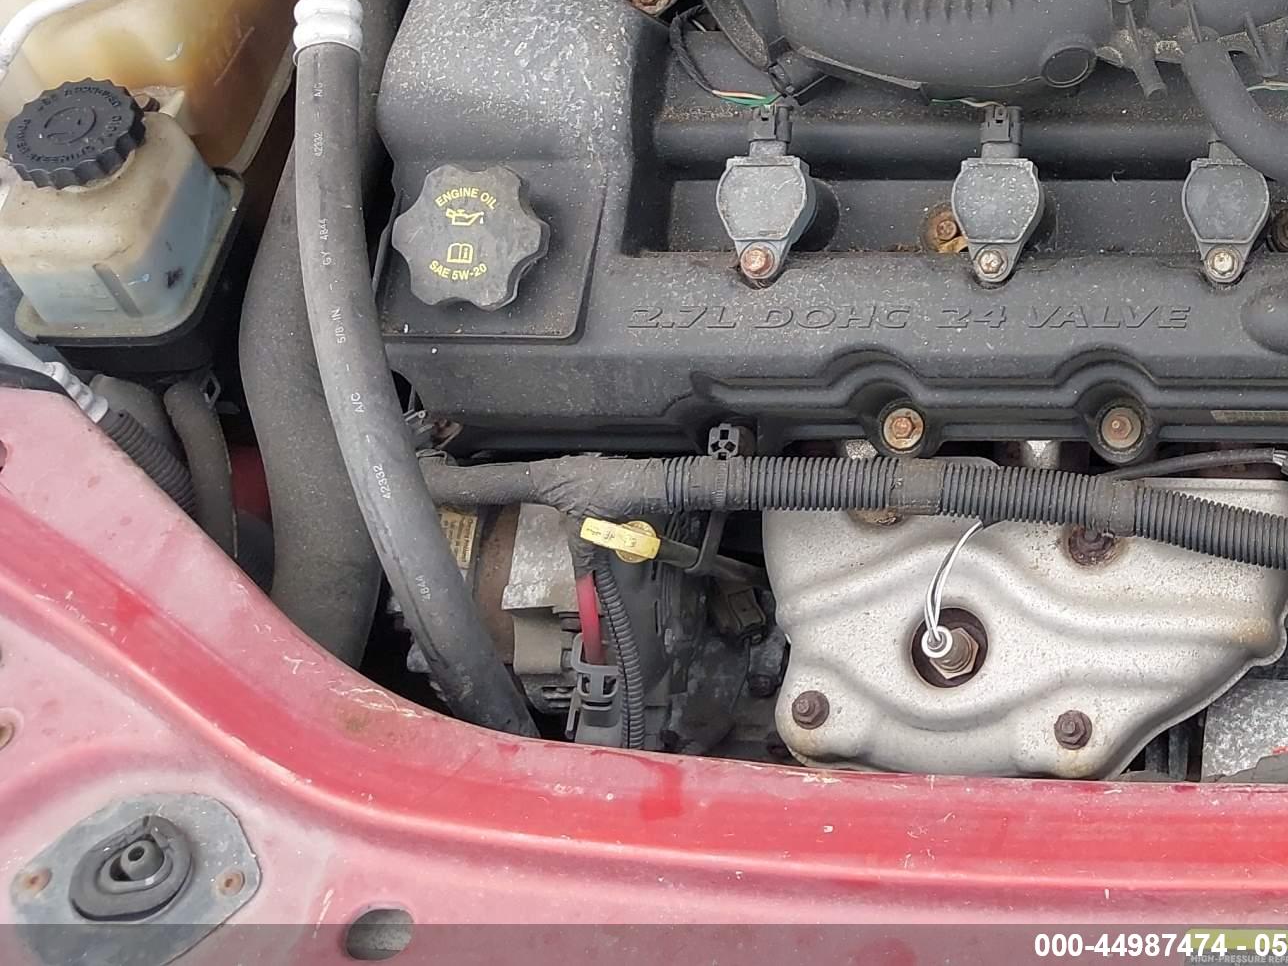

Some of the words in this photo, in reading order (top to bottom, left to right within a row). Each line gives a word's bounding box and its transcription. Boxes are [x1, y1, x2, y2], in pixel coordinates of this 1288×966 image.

[313, 132, 324, 158] 42332
[435, 187, 480, 208] ENGINE
[480, 192, 499, 210] OIL
[321, 250, 333, 266] GY
[429, 260, 450, 280] SAE
[451, 263, 488, 281] 5W-20
[627, 305, 739, 329] 2.7L
[753, 305, 911, 329] DOHC
[936, 305, 1008, 329] 24
[1027, 305, 1192, 329] VALVE
[351, 392, 365, 413] A/C
[372, 464, 391, 499] 42332
[1190, 955, 1267, 964] HIGH-PRESSURE
